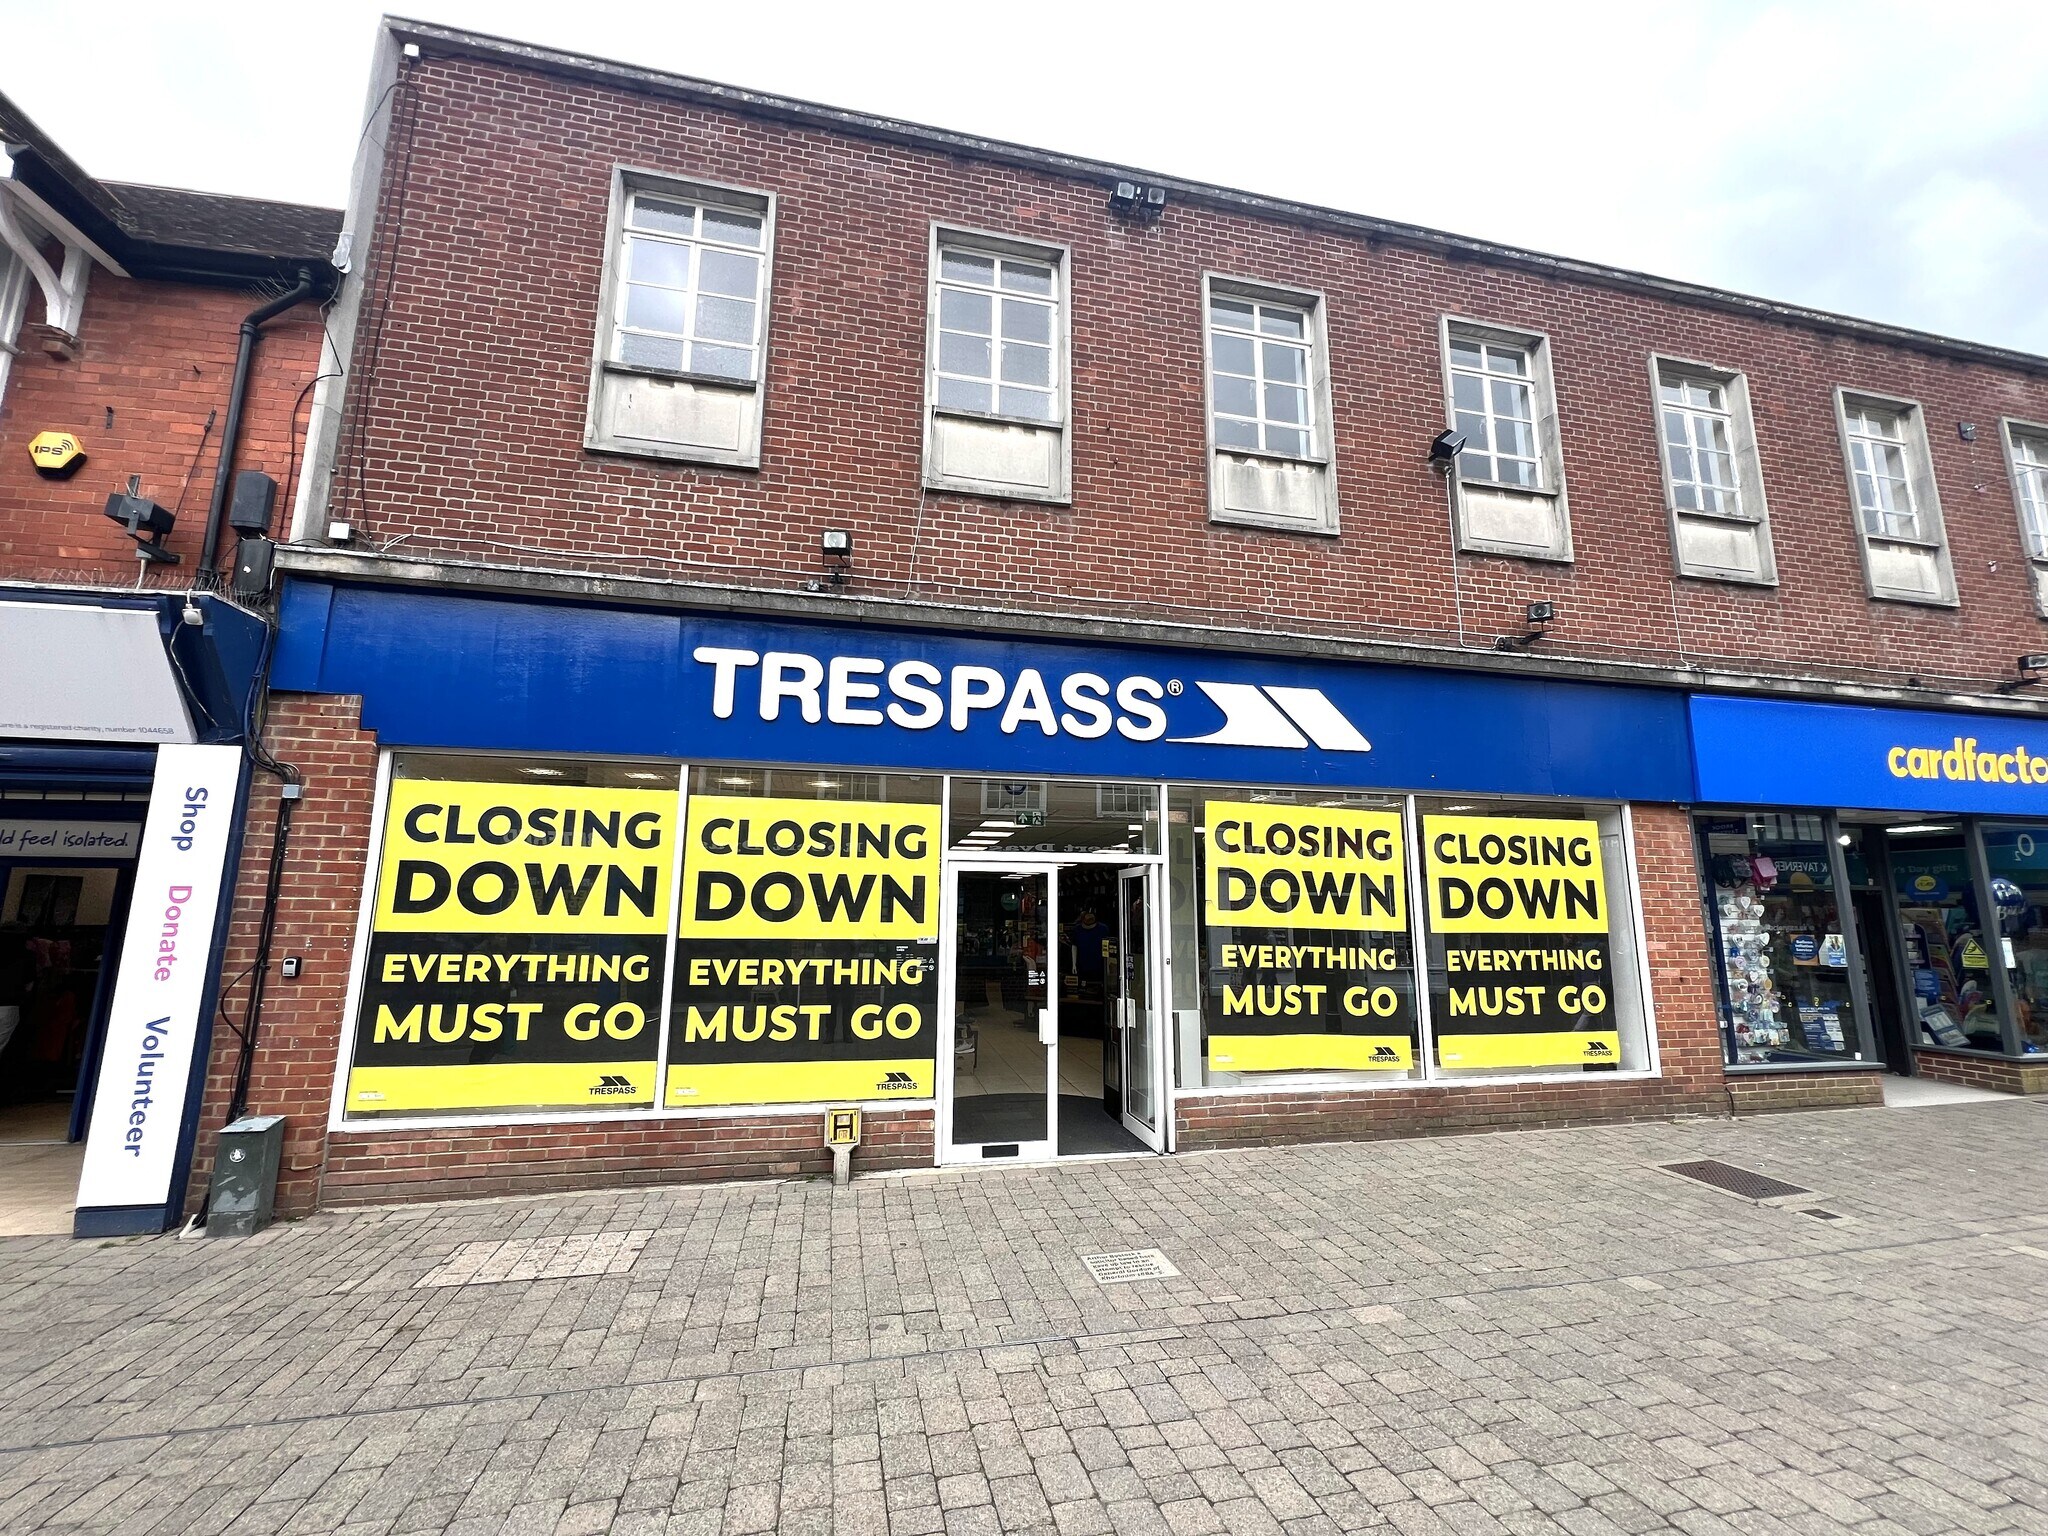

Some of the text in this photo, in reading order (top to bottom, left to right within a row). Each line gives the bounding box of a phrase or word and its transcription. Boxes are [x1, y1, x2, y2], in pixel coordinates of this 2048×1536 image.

[34, 446, 63, 456] IPS
[30, 724, 72, 732] registered
[138, 726, 175, 735] 1044658
[1888, 737, 2048, 784] cardfacto
[171, 787, 208, 851] Shop
[404, 803, 662, 850] CLOSING
[19, 829, 58, 851] feel
[63, 830, 129, 847] isolated.
[701, 817, 927, 860] CLOSING
[1214, 819, 1393, 862] CLOSING
[1433, 832, 1592, 867] CLOSING
[1932, 864, 1959, 875] gifts
[392, 859, 658, 918] DOWN
[694, 870, 926, 924] DOWN
[1217, 865, 1397, 918] DOWN
[1439, 876, 1599, 920] DOWN
[154, 886, 192, 982] Donate
[382, 953, 650, 983] EVERYTHING
[688, 958, 924, 987] EVERYTHING
[1221, 944, 1396, 971] EVERYTHING
[1446, 949, 1602, 971] EVERYTHING
[1222, 984, 1399, 1018] MUST GO
[1448, 985, 1607, 1016] MUST GO
[372, 1001, 646, 1043] MUST GO
[685, 1003, 922, 1042] MUST GO
[1368, 1055, 1400, 1063] TRESPASS
[125, 1016, 171, 1157] Volunteer
[588, 1086, 637, 1095] TRESPASS
[876, 1082, 918, 1091] TRESPASS
[833, 1113, 853, 1140] H
